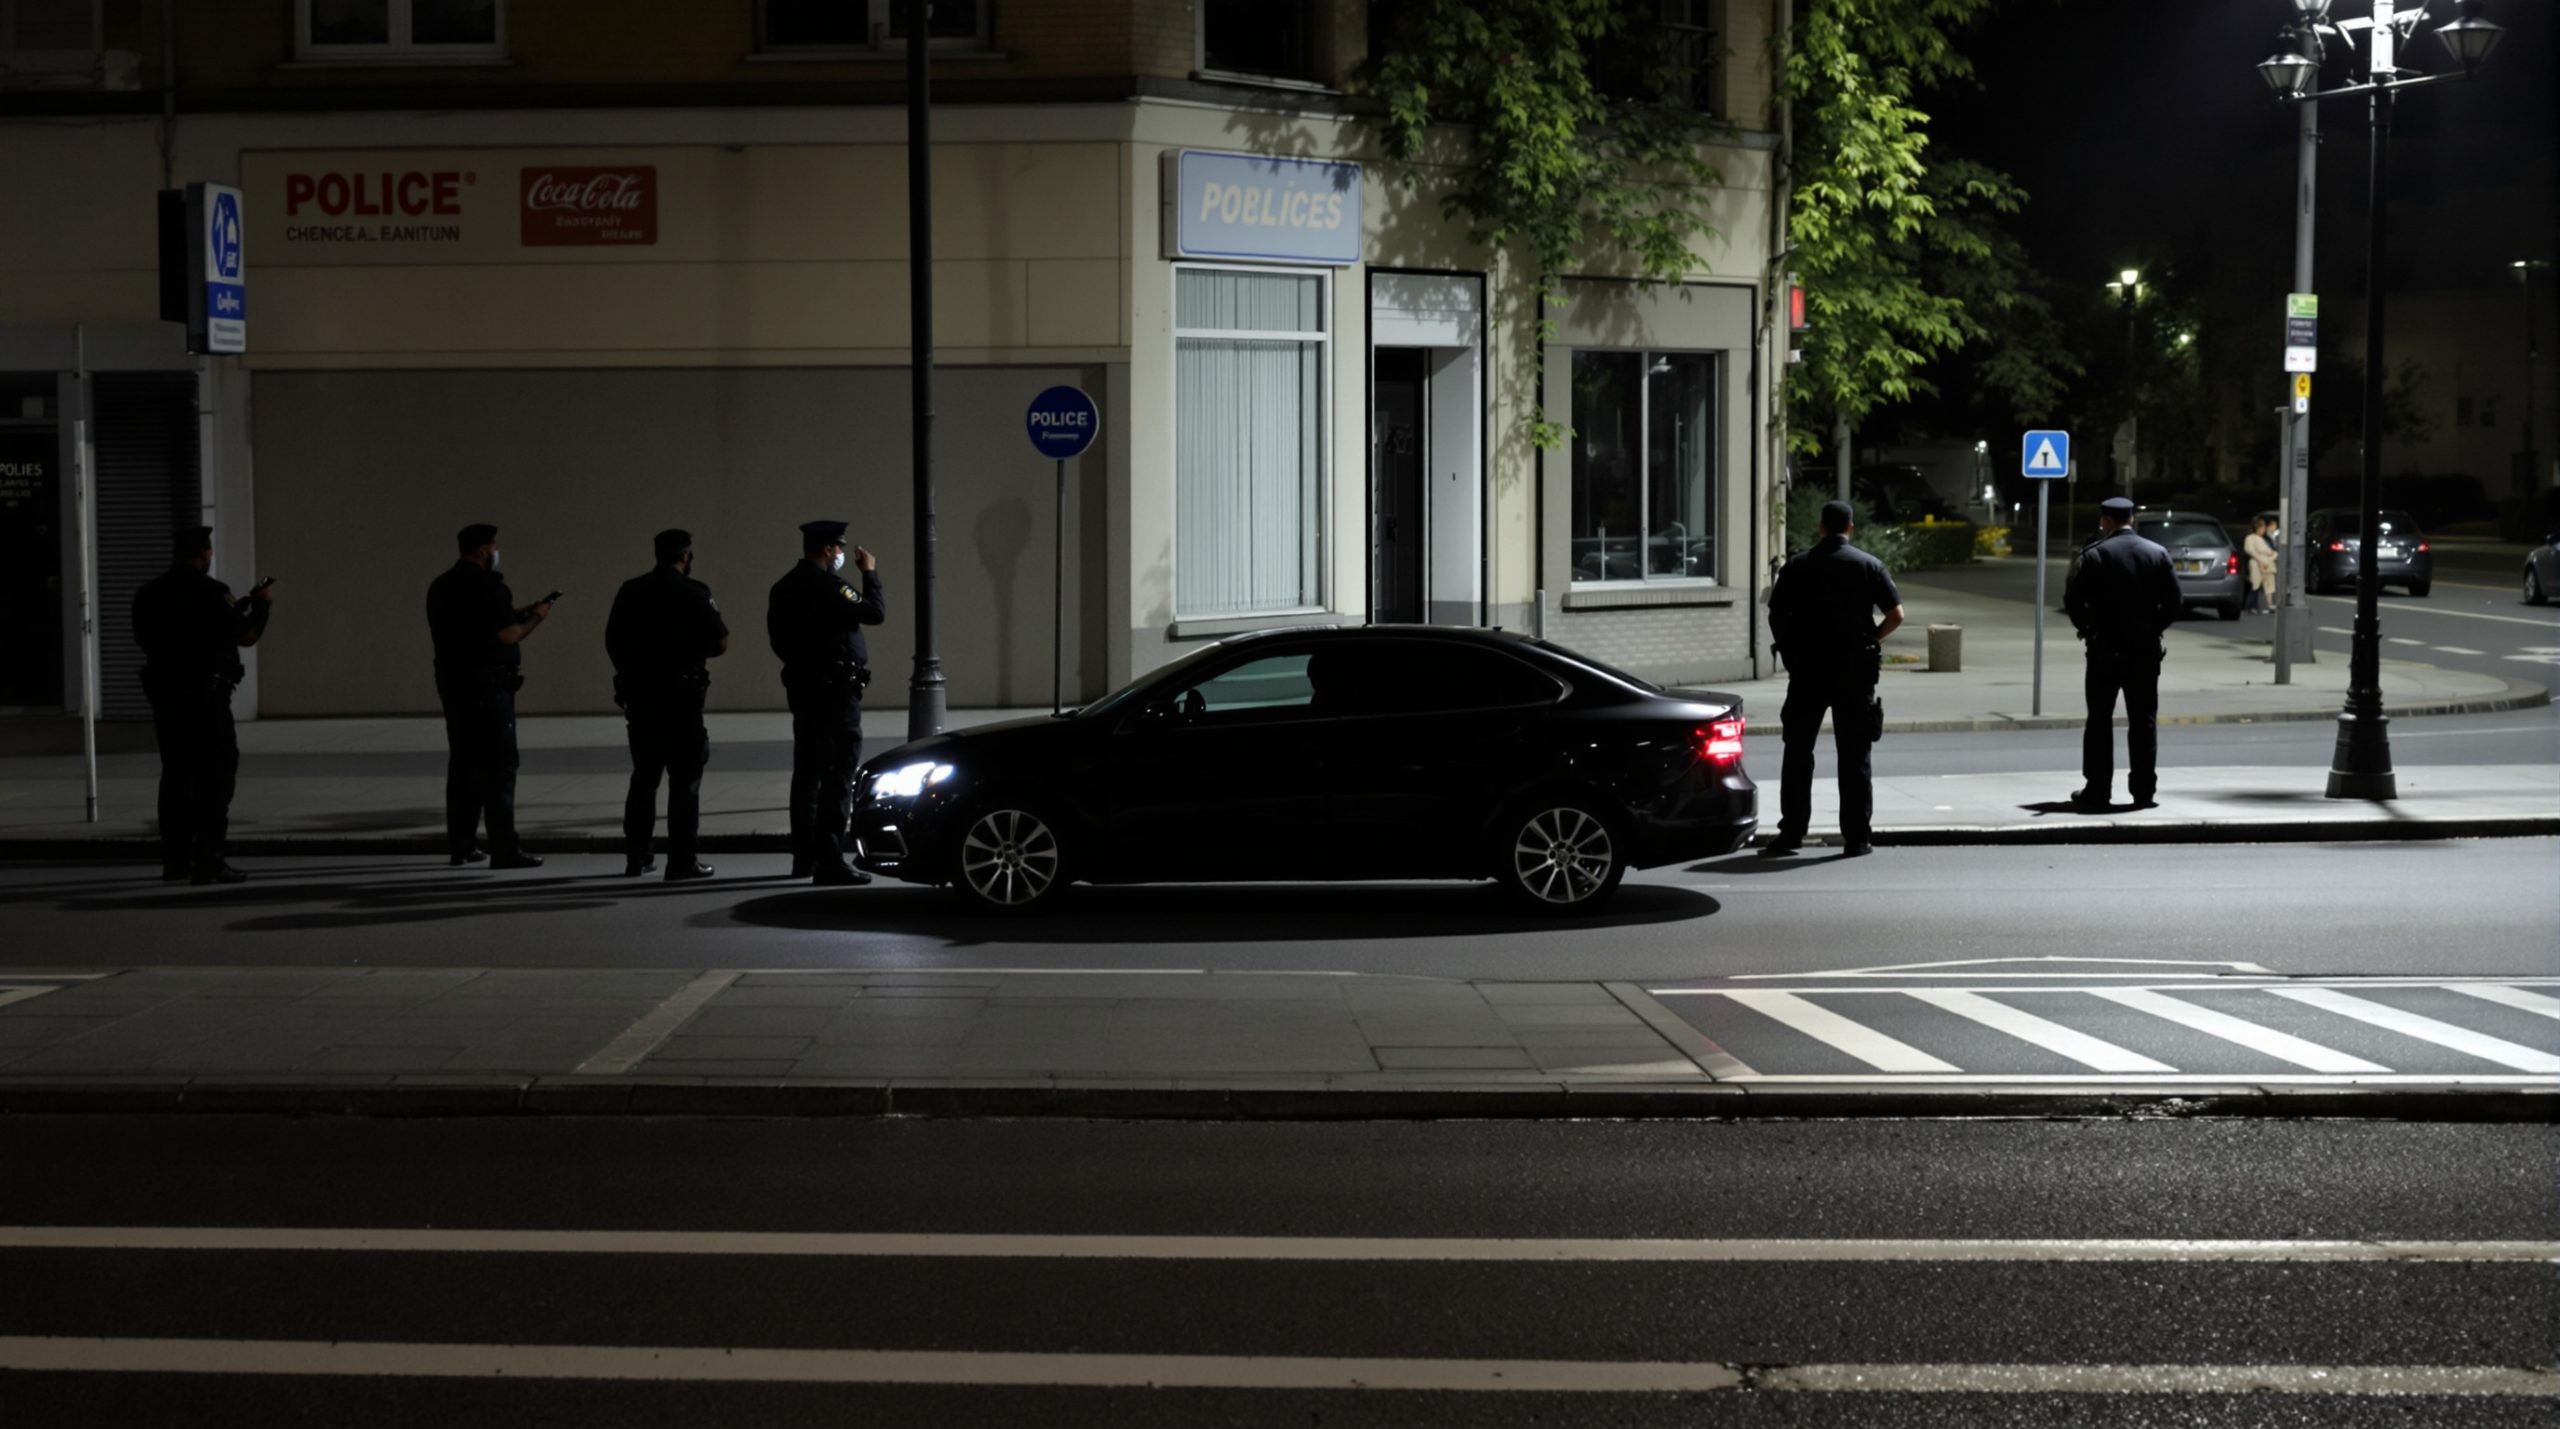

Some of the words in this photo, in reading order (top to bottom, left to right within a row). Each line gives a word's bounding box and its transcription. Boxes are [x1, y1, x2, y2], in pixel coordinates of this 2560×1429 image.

[286, 171, 461, 217] POLICE
[527, 172, 643, 212] Coca-Cola
[1030, 411, 1089, 426] POLICE
